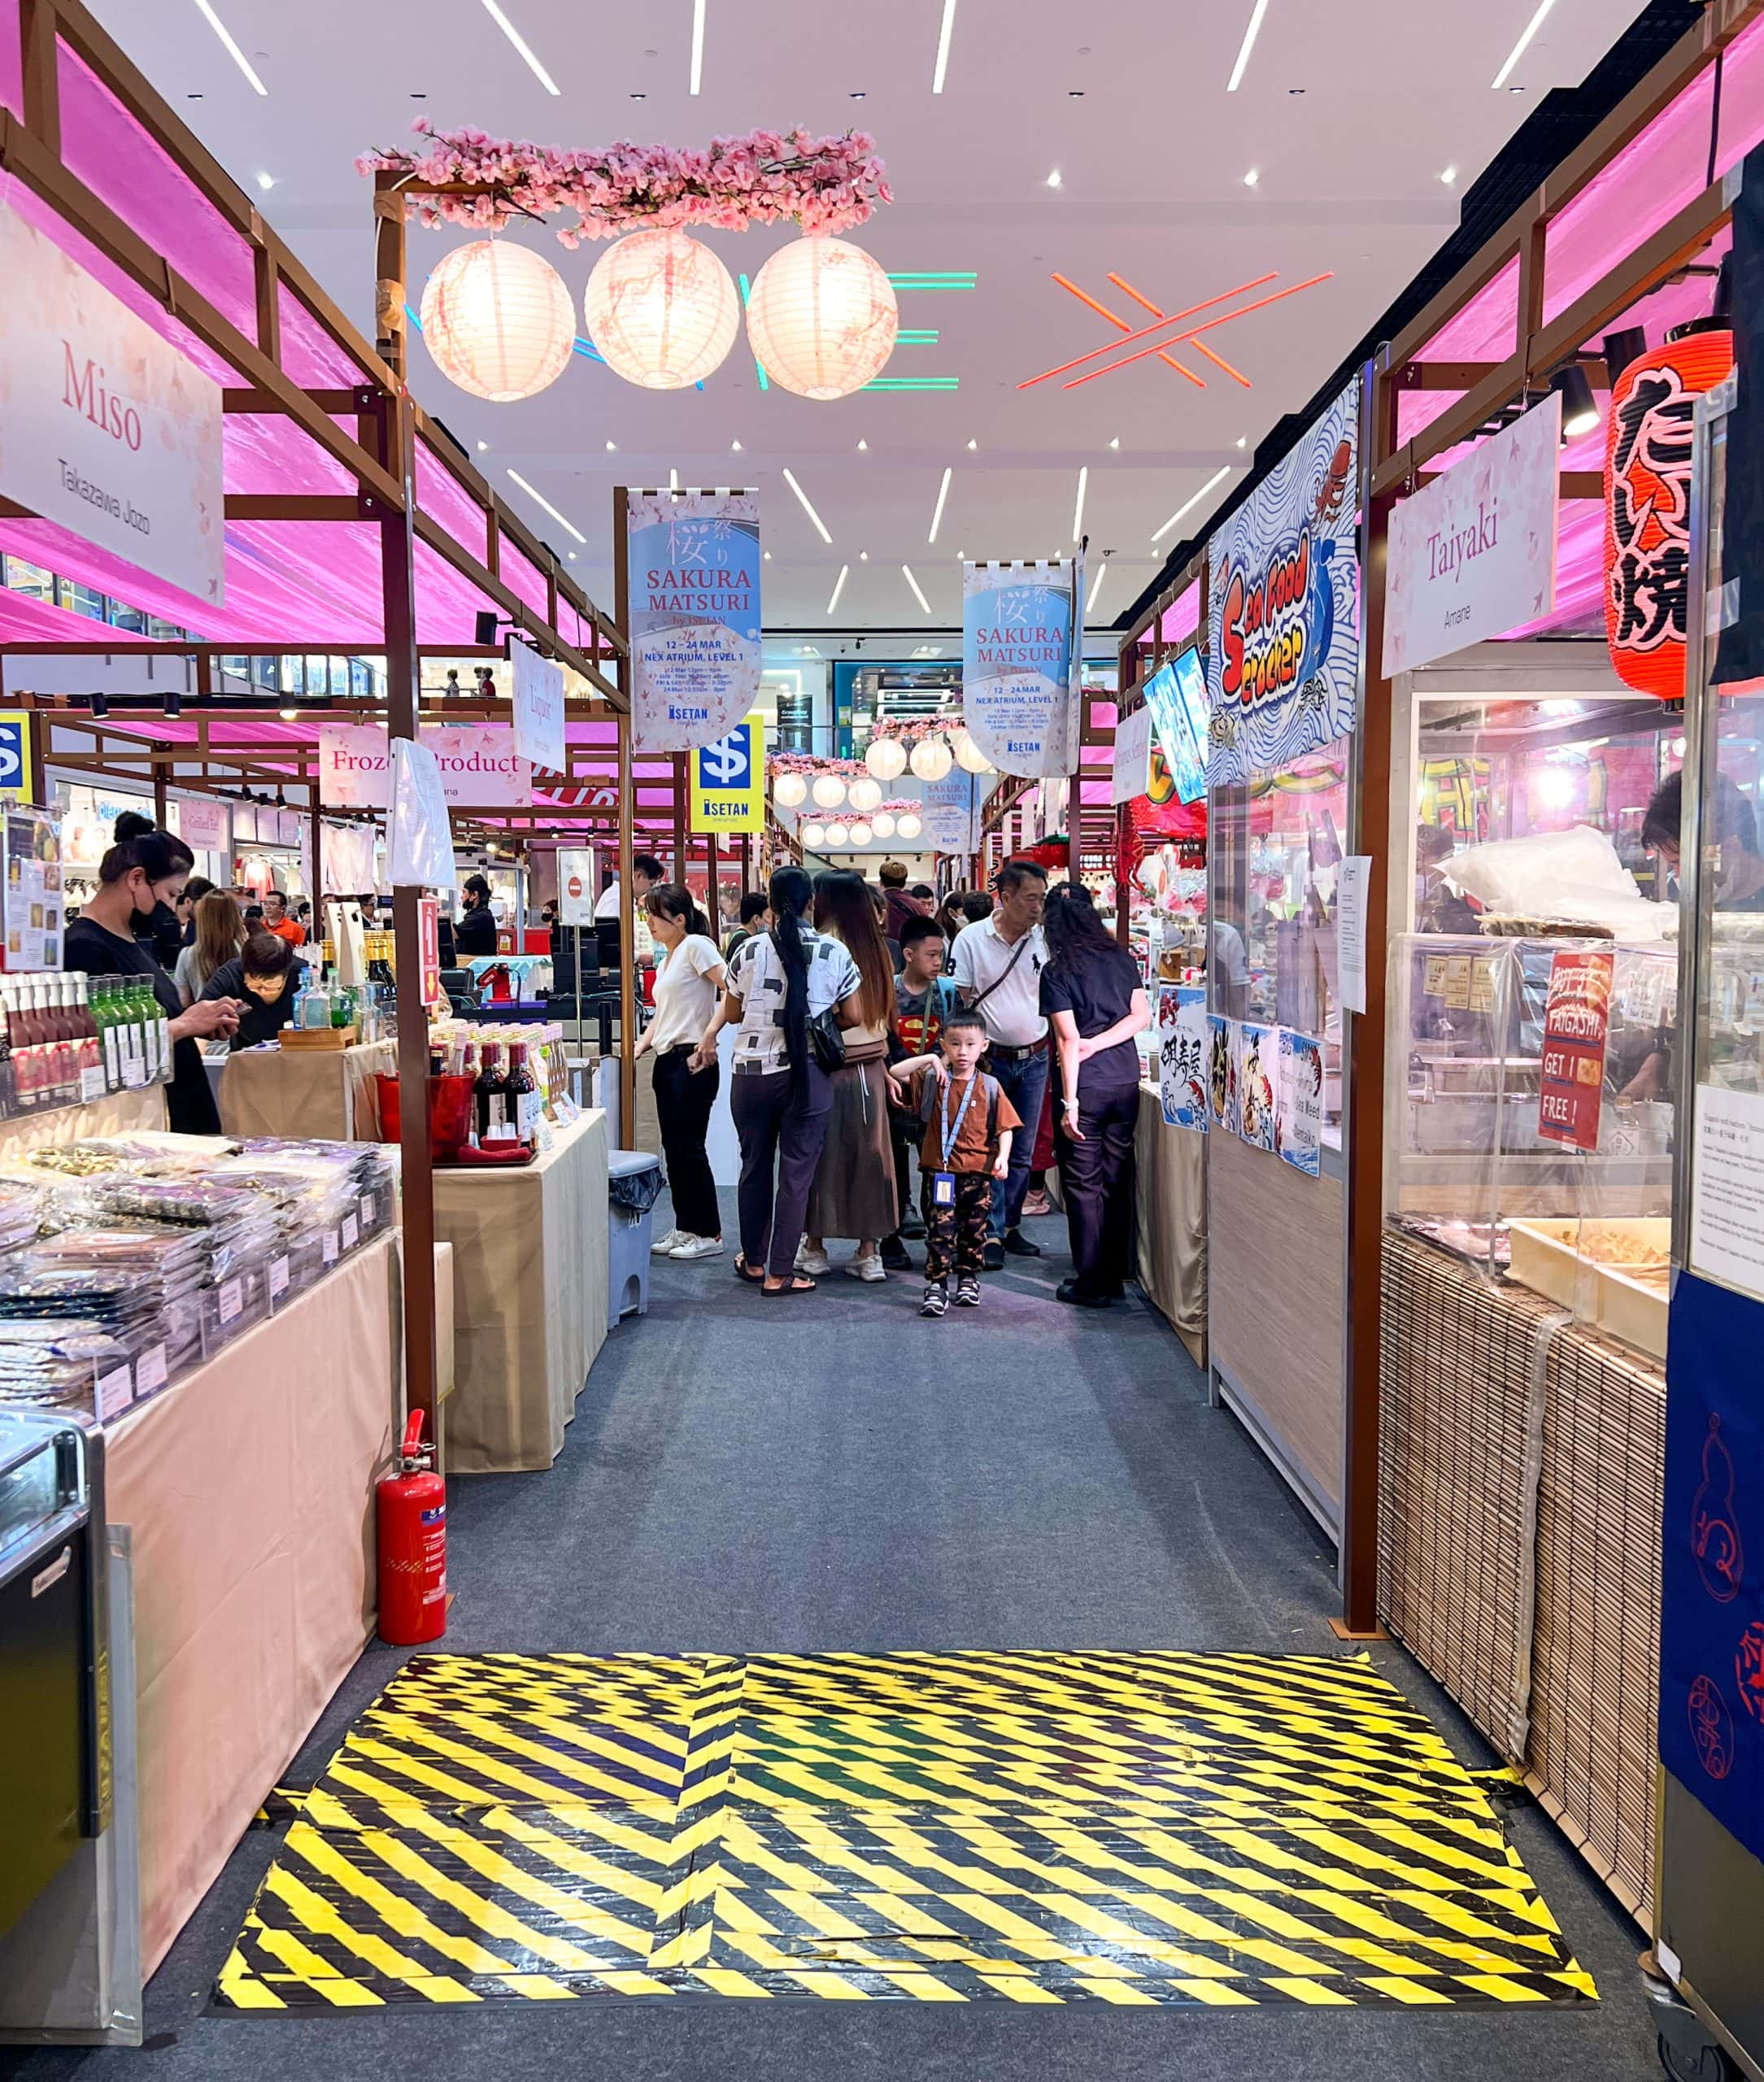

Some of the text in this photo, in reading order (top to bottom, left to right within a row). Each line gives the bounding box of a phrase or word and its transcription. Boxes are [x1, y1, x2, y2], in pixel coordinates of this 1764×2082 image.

[62, 339, 142, 451] Miso
[59, 459, 150, 535] Takazawa Jozo
[1426, 497, 1498, 583] Taiyaki
[647, 568, 751, 590] SAKURA
[648, 594, 750, 612] MATSURI
[1444, 603, 1471, 629] Amane
[665, 641, 677, 649] 12
[686, 641, 697, 649] 24
[699, 640, 721, 649] MAR
[976, 627, 1063, 644] SAKURA
[645, 653, 743, 663] NEX ATRIUM, LEVEL 1
[978, 647, 1061, 663] MATSURI
[669, 704, 708, 720] ISETAN
[1008, 739, 1041, 752] ISETAN
[333, 751, 390, 771] Froz
[926, 784, 969, 793] SAKURA
[702, 799, 748, 816] ISETAN
[1544, 1052, 1566, 1076] GET
[1305, 1100, 1320, 1120] Weed
[1542, 1095, 1569, 1121] FREE
